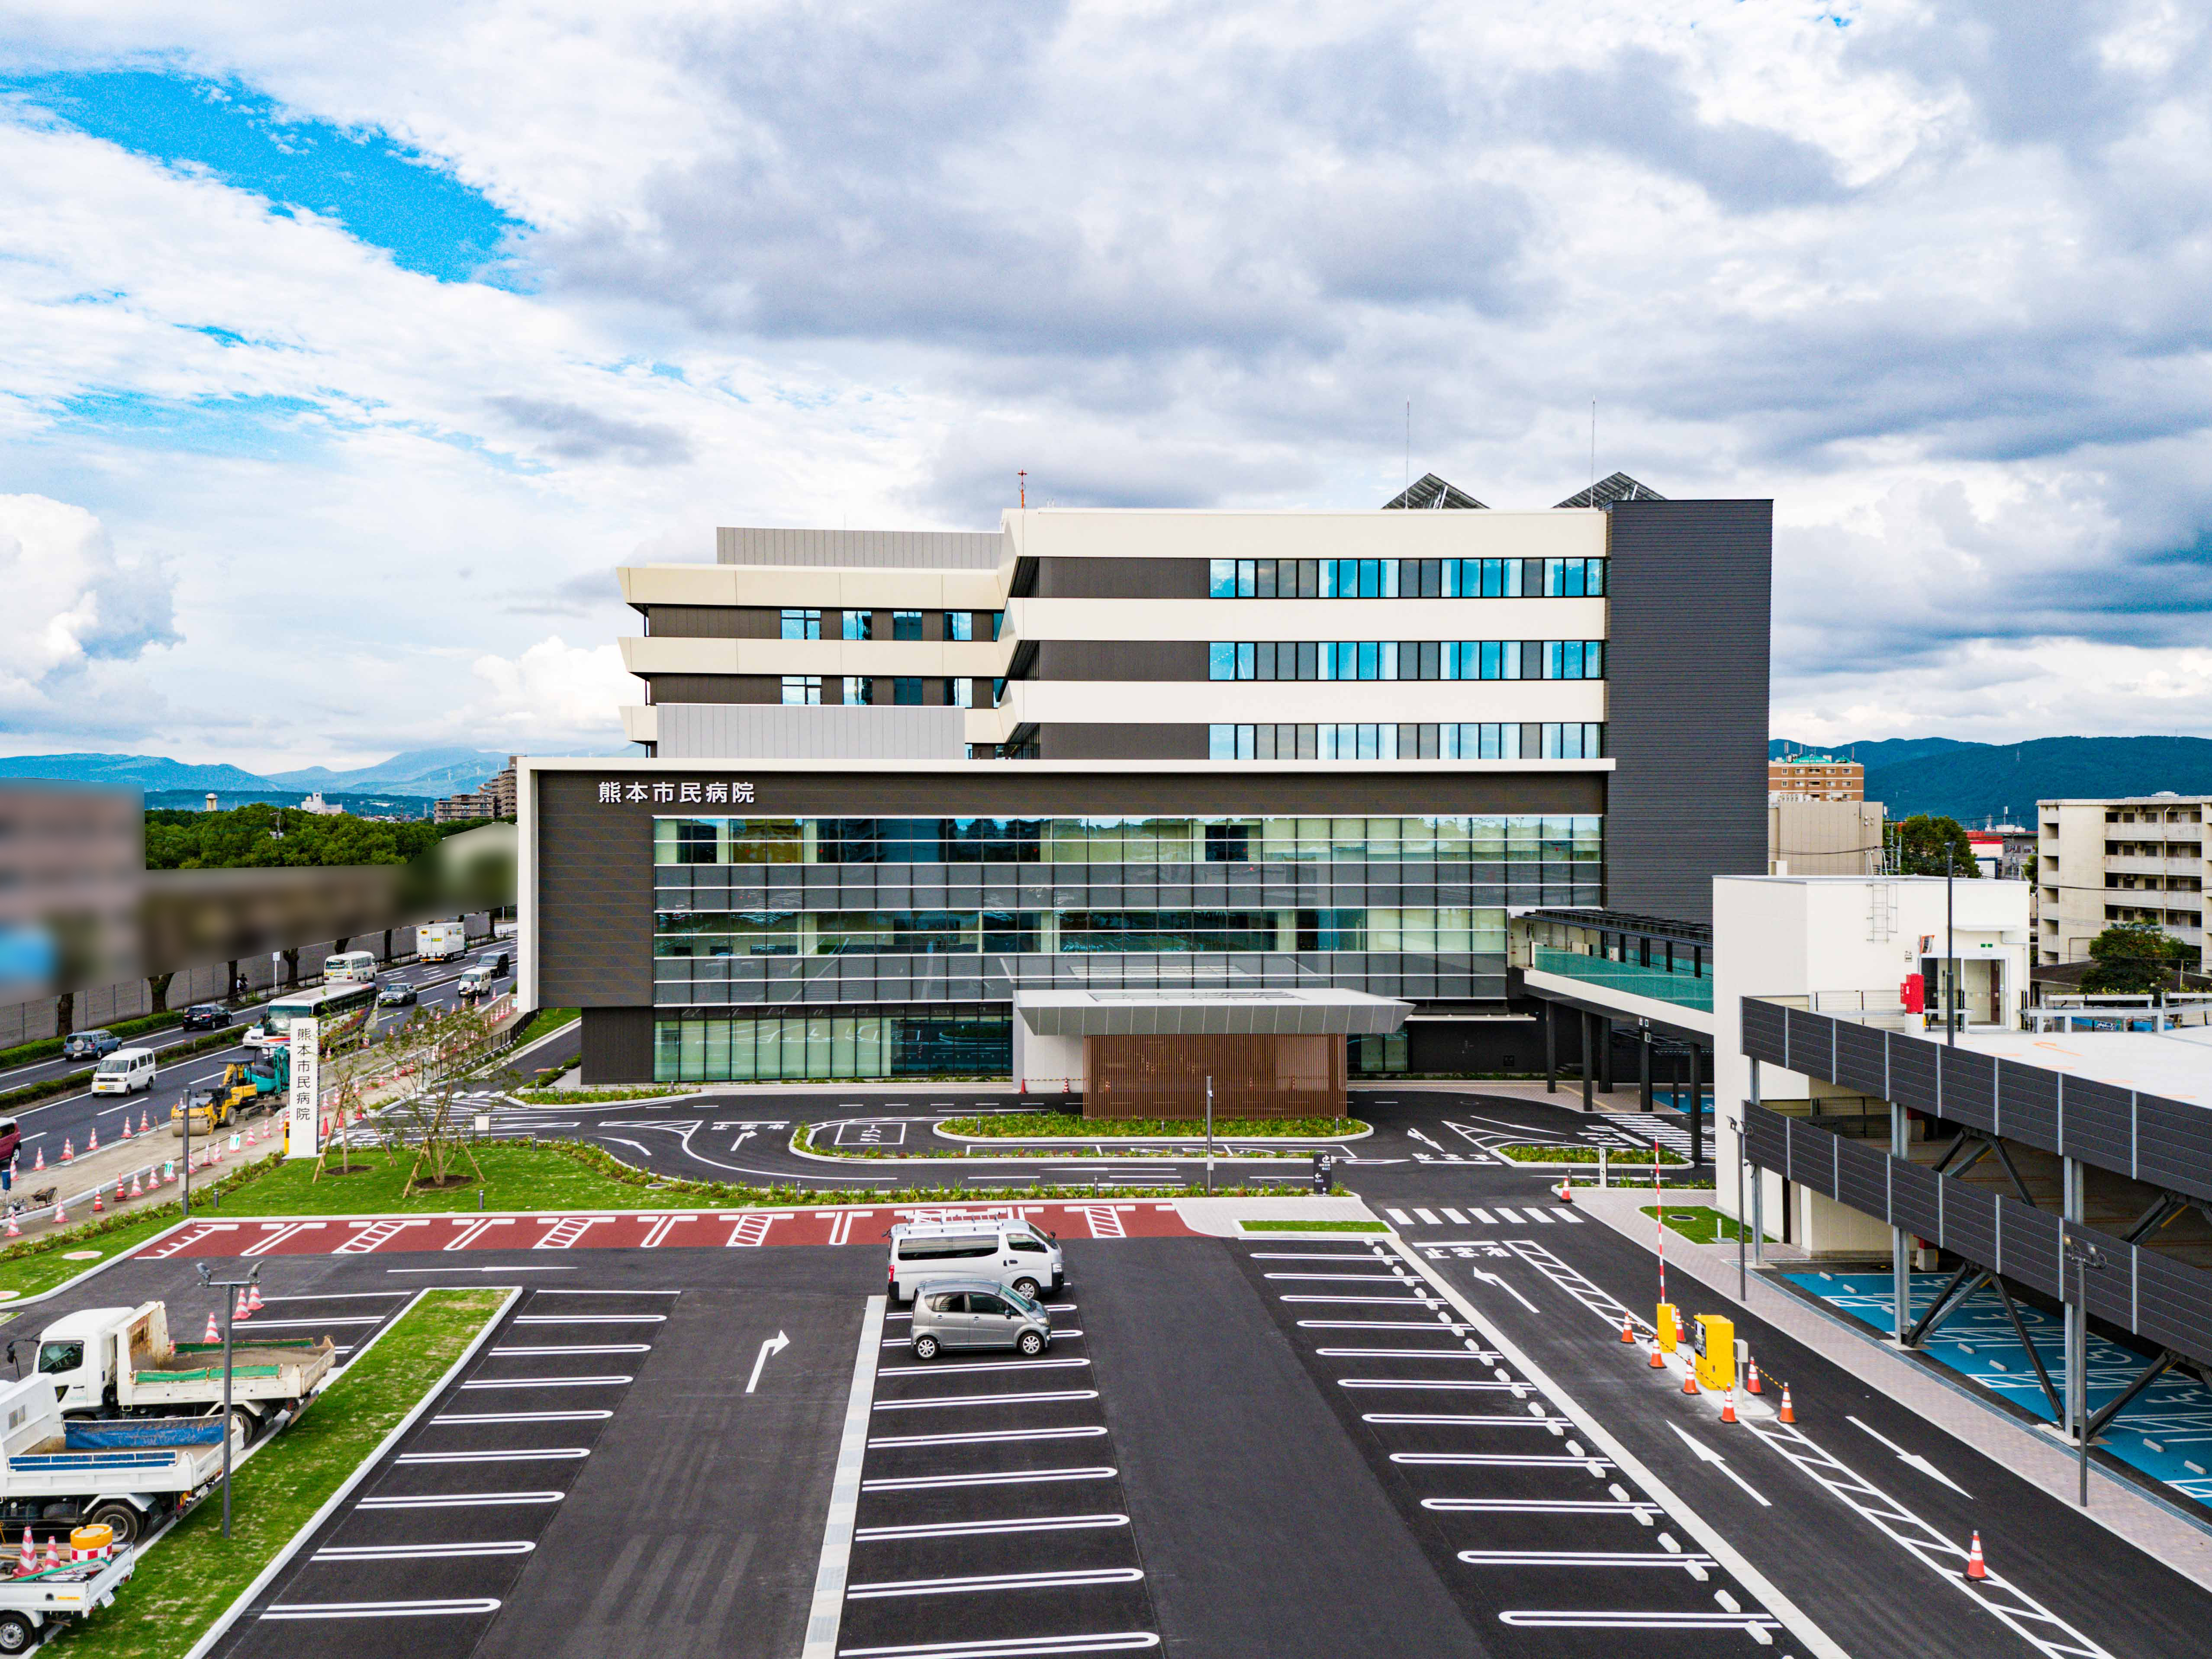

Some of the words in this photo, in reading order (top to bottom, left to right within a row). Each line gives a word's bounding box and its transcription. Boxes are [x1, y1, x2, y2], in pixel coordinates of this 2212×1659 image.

[599, 782, 754, 803] 熊本市民病院
[296, 1028, 312, 1120] 熊本市民病院
[1424, 1247, 1512, 1259] 止まれ
